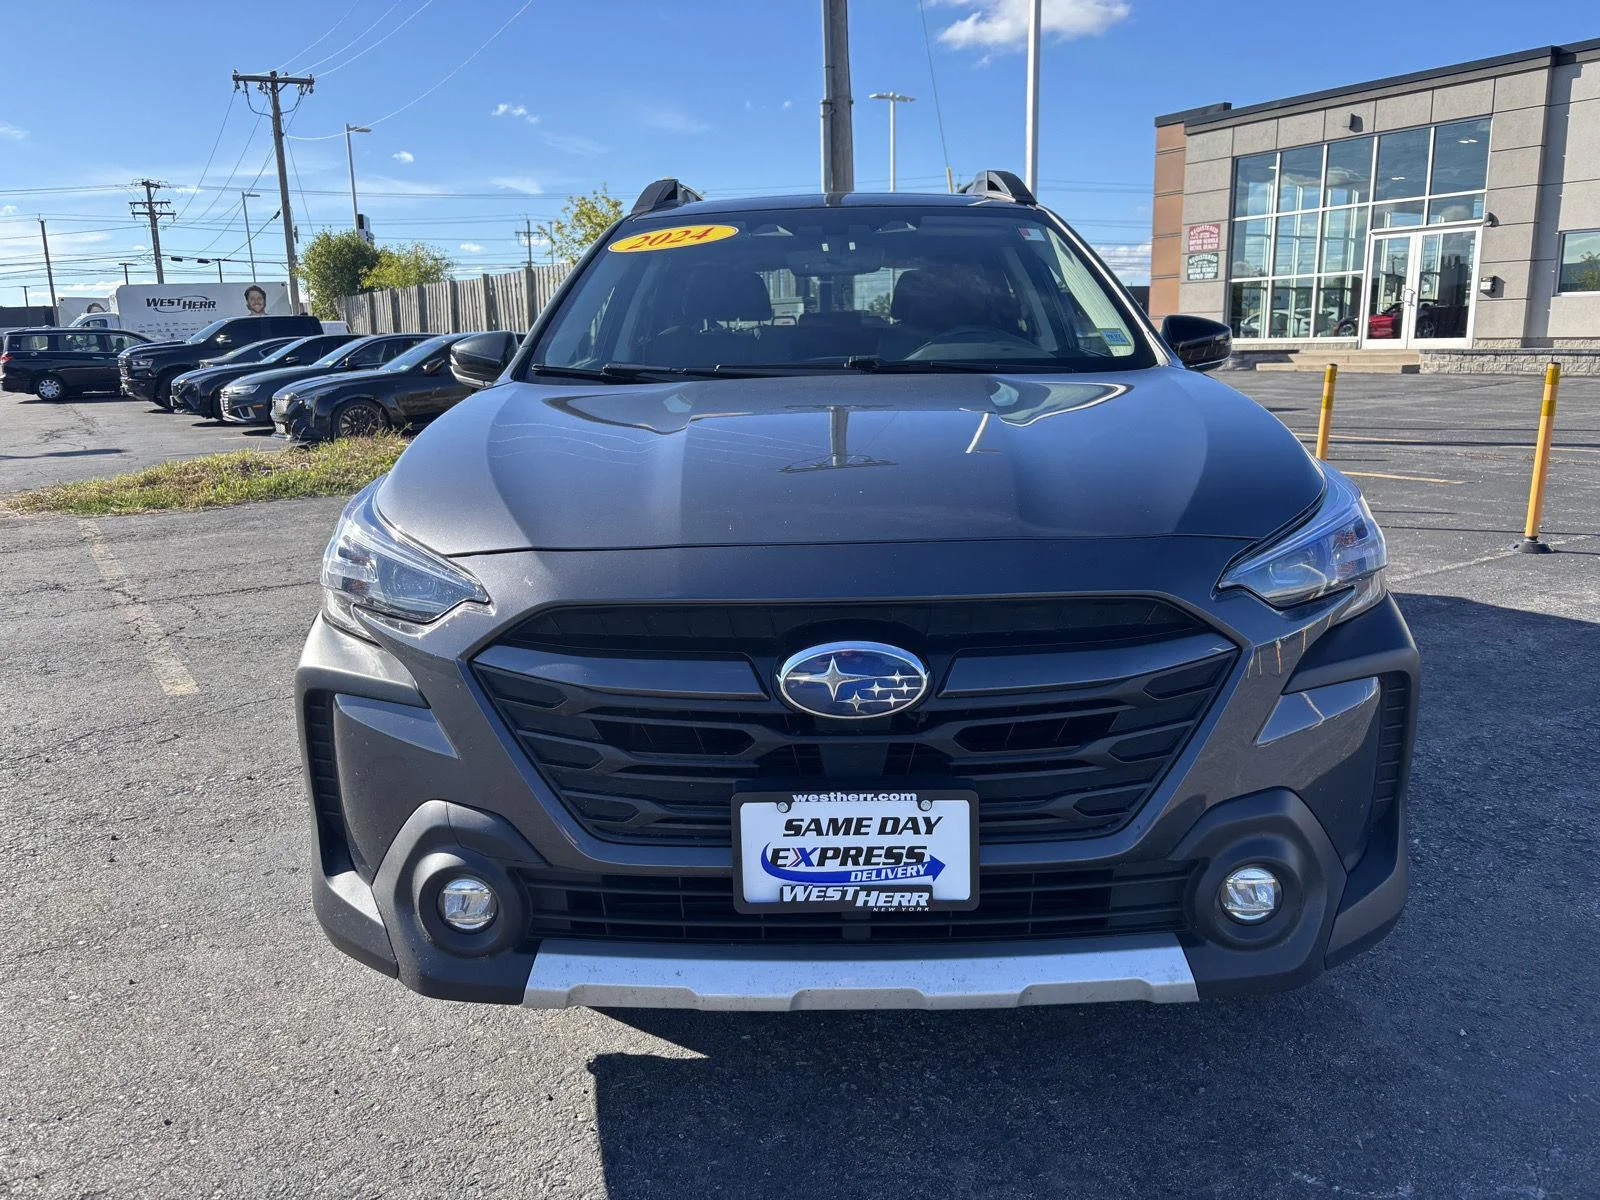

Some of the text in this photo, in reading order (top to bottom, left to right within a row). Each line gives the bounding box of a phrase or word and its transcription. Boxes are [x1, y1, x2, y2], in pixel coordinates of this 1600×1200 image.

[627, 227, 715, 250] 2024
[146, 298, 217, 309] WEST HERR
[792, 792, 917, 803] westherr.com
[783, 816, 943, 837] SAME DAY
[770, 845, 928, 868] EXPRESS
[850, 864, 928, 883] DELIVERY
[781, 885, 930, 907] WEST HERR
